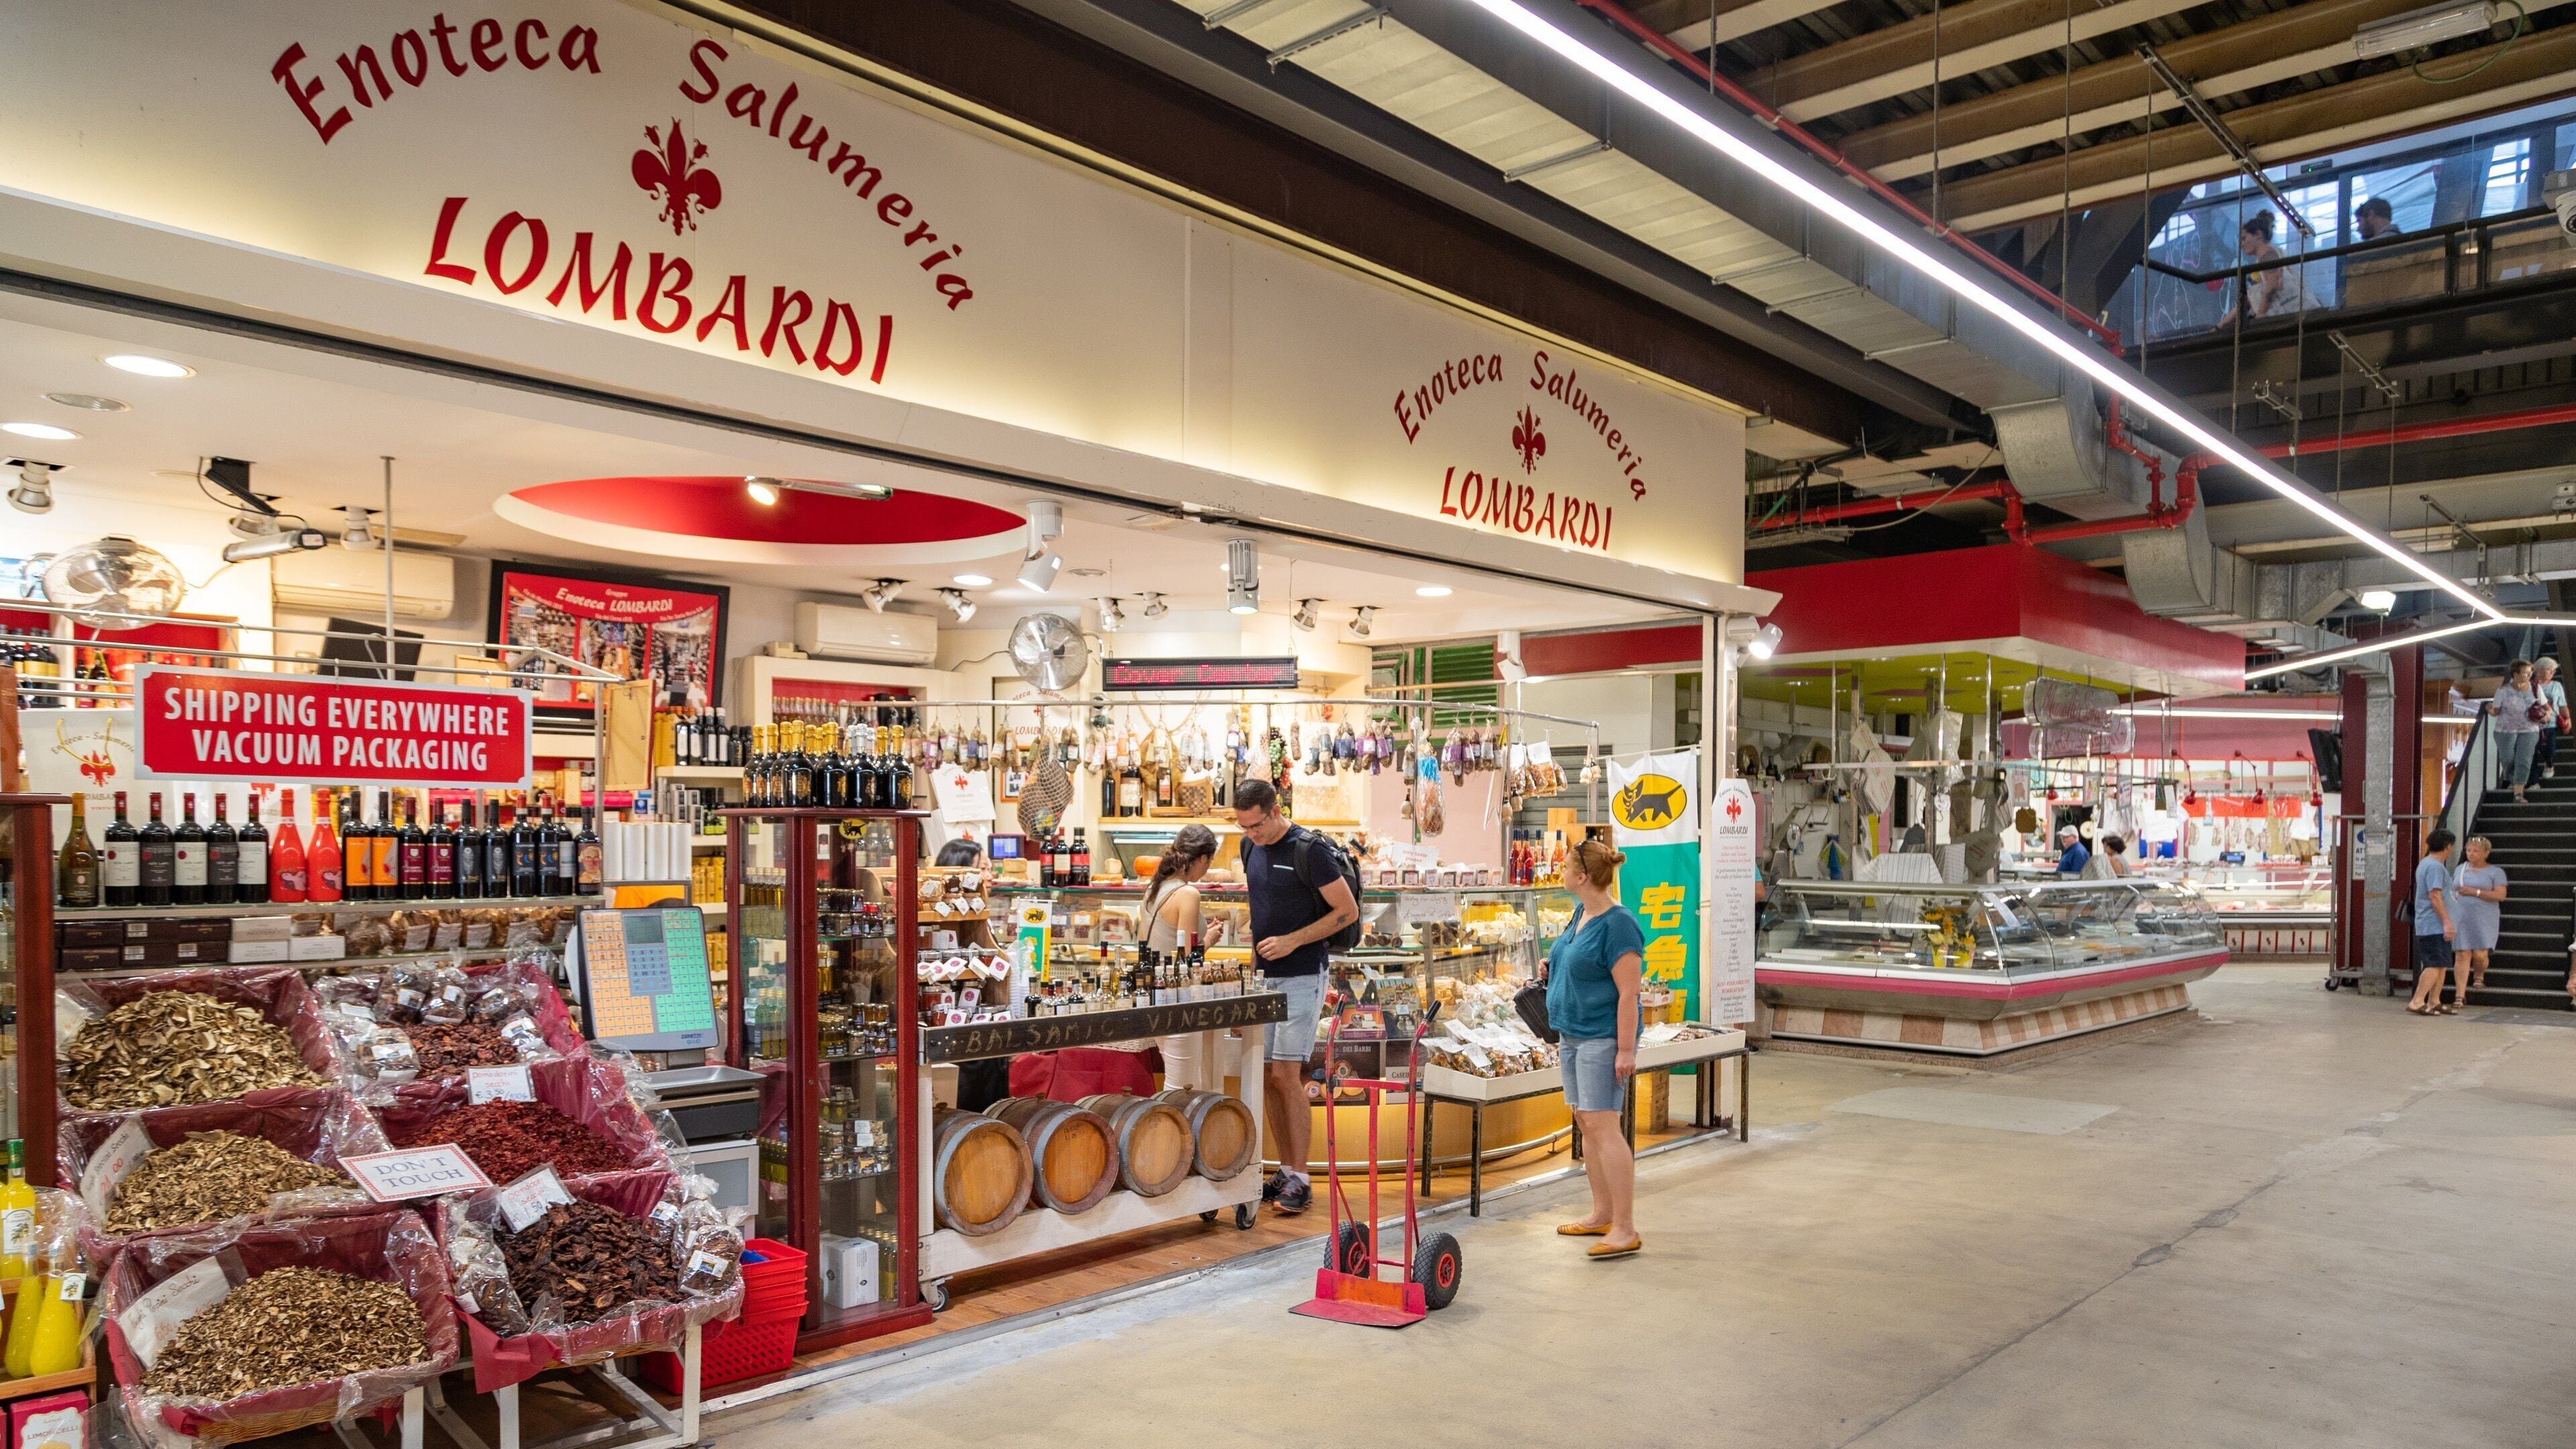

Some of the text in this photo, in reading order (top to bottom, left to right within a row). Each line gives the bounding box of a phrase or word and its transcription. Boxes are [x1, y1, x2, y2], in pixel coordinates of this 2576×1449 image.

[271, 13, 974, 311] Enoteca Salumeria
[423, 197, 893, 384] LOMBARDI
[1394, 350, 1646, 502] Enoteca Salumeria
[1440, 466, 1611, 551] LOMBARDI
[555, 587, 605, 610] Enoteca
[610, 598, 674, 613] LOMBARDI
[164, 687, 509, 737] SHIPPING EVERYWHERE
[192, 729, 487, 771] VACUUM PACKAGING
[1719, 826, 1748, 835] LOMBARDI
[965, 1002, 1257, 1055] BALSAMIC VINEGAR
[382, 1169, 465, 1187] TOUCH
